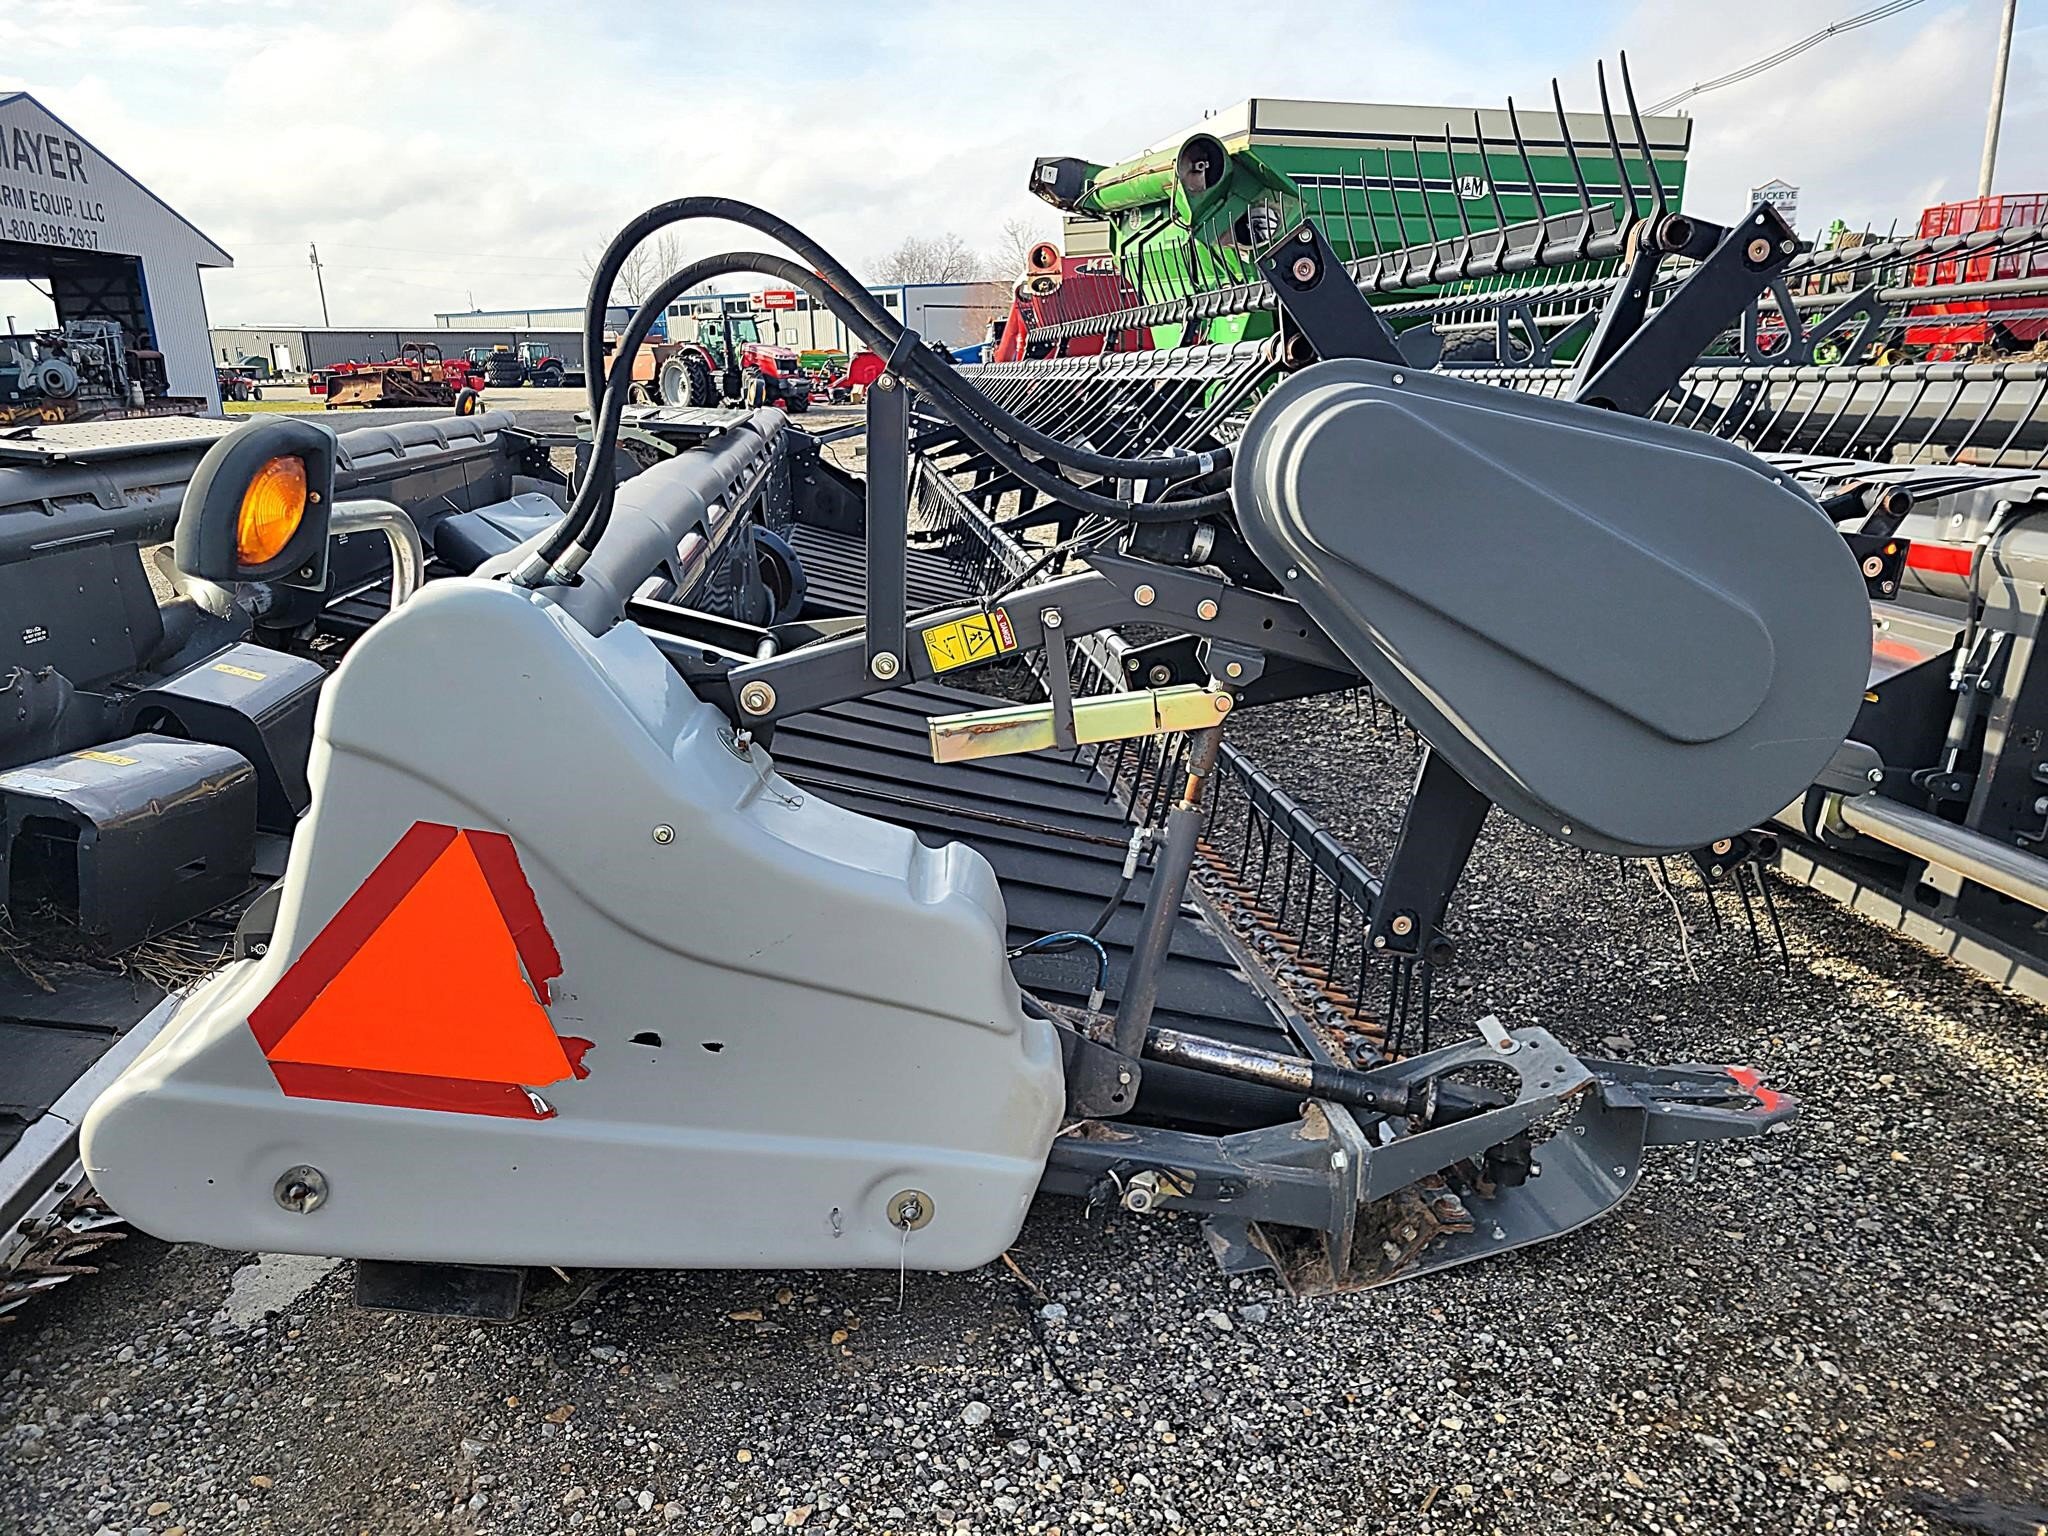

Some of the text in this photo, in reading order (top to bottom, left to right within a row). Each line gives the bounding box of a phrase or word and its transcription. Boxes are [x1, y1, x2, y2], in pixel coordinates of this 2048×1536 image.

[30, 190, 77, 217] EQUIP.
[79, 200, 105, 222] LLC
[1752, 191, 1798, 200] BUCKEYE
[0, 217, 98, 249] 1-800-996-2937
[1000, 621, 1013, 646] DANGER
